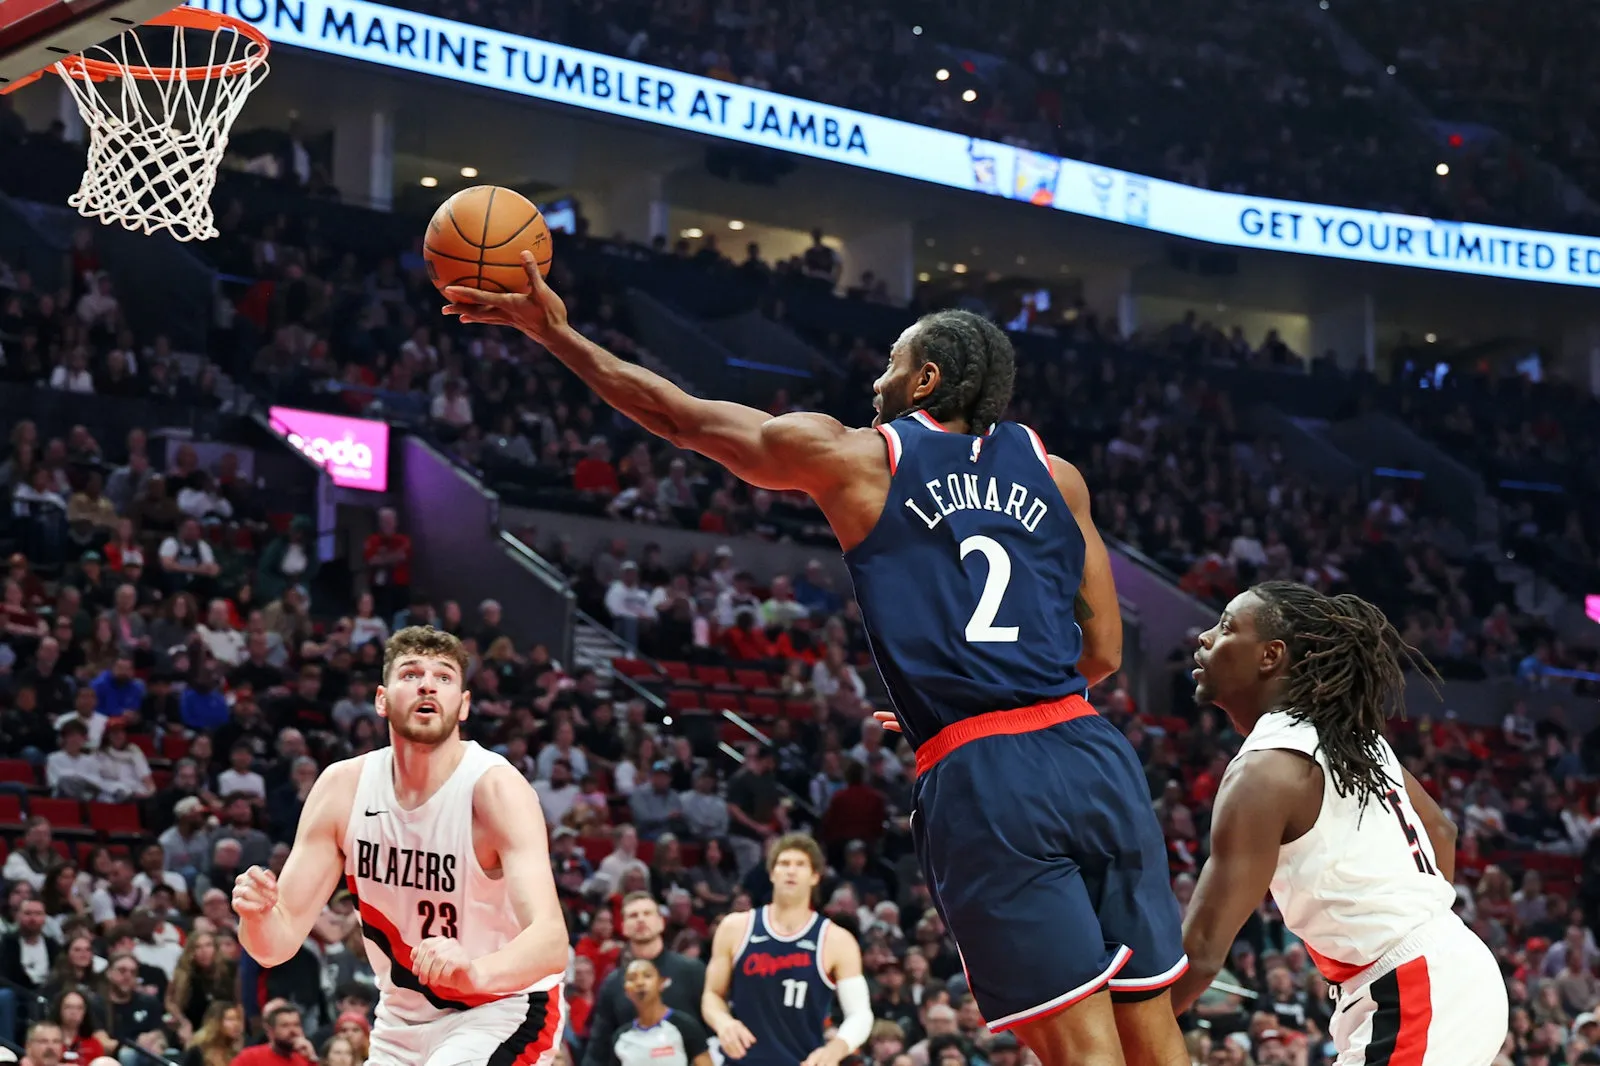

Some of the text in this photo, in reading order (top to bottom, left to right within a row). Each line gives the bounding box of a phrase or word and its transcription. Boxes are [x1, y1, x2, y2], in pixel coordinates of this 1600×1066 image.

[321, 7, 489, 73] MARINE
[501, 45, 676, 114] TUMBLER
[689, 89, 732, 124] AT
[743, 102, 867, 155] JAMBA
[1239, 207, 1600, 275] GET YOUR LIMITED ED
[904, 473, 1048, 533] LEONARD
[959, 534, 1020, 643] 2
[356, 838, 457, 893] BLAZERS
[417, 899, 458, 940] 23
[782, 978, 808, 1010] 11
